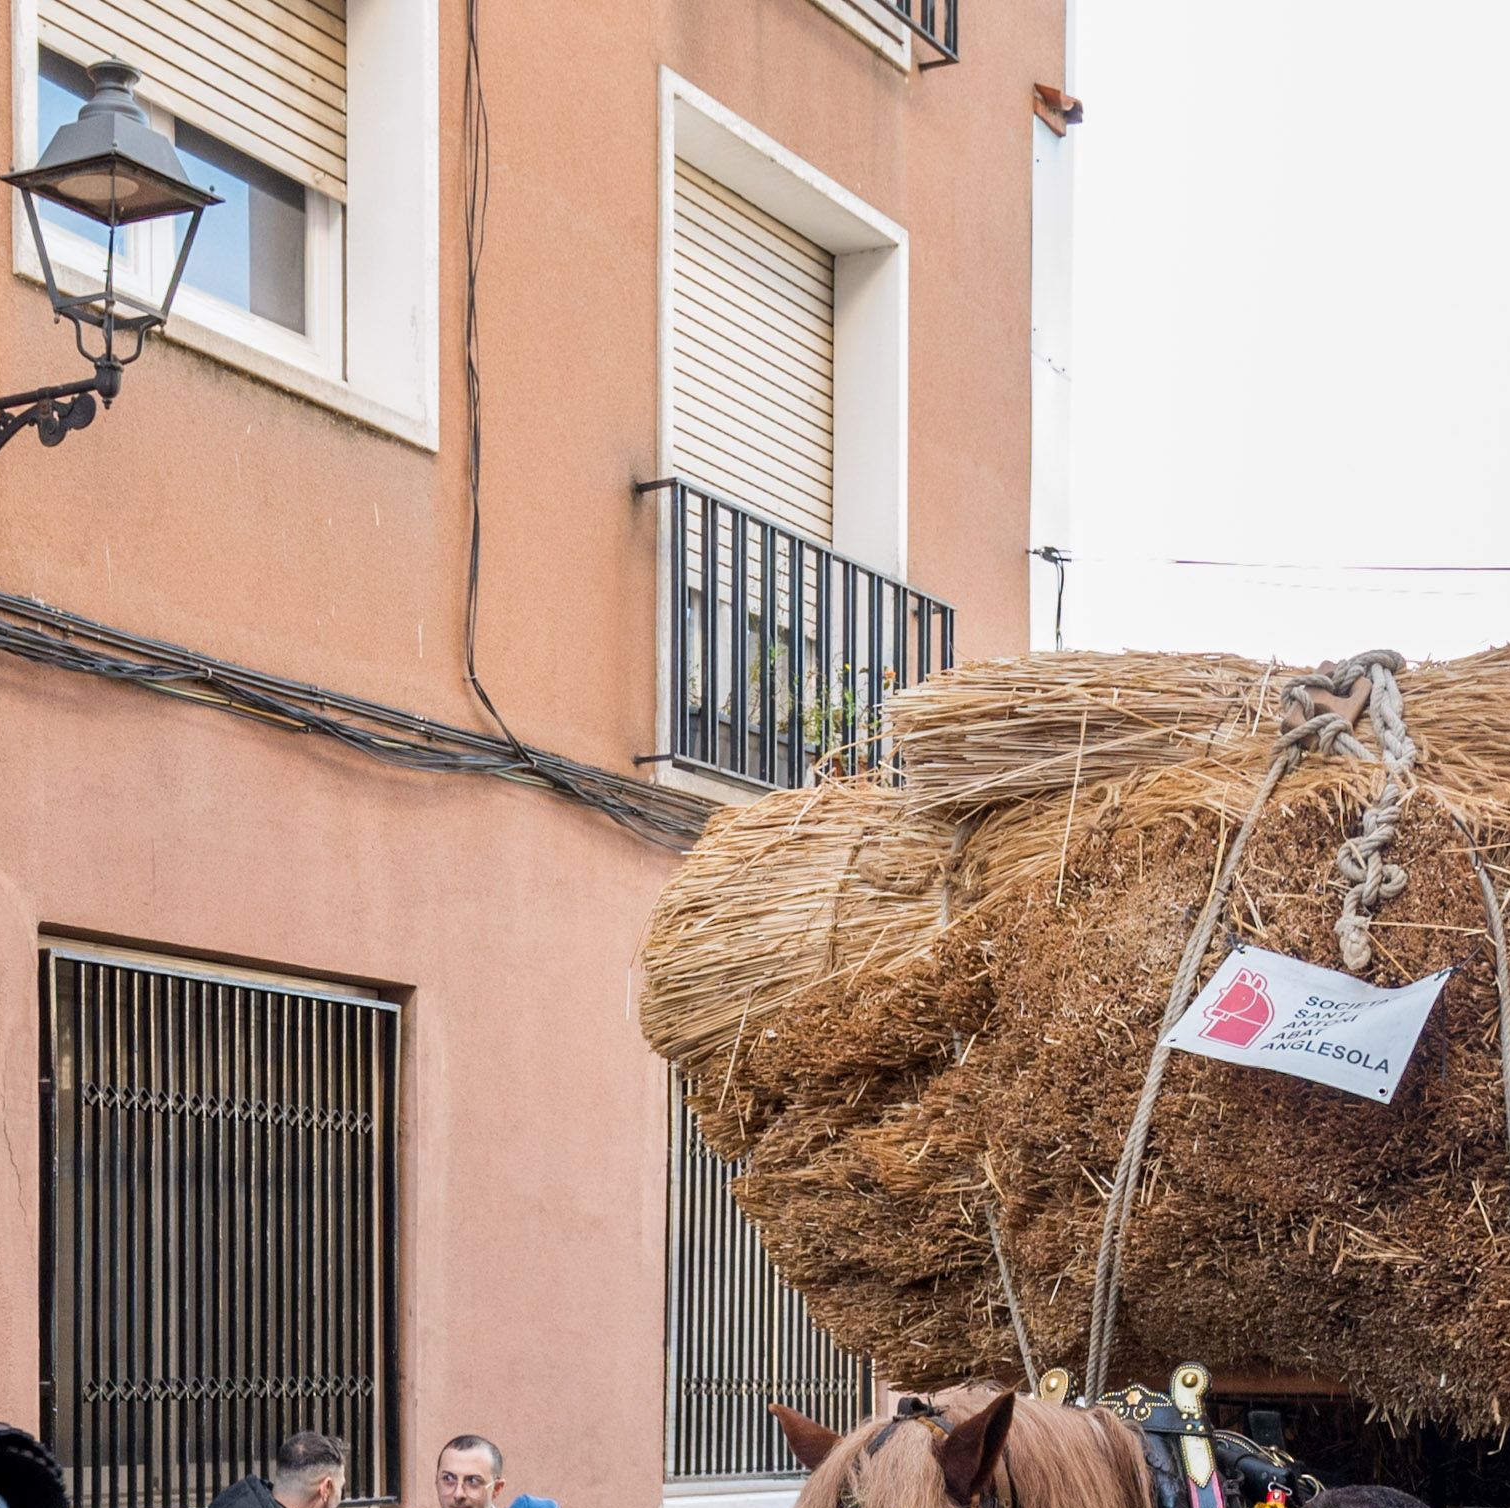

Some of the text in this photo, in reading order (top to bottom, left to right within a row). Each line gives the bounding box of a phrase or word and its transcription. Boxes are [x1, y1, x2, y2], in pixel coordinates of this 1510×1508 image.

[1305, 995, 1394, 1010] SOCIETA
[1283, 1014, 1359, 1029] ANTONI
[1295, 1009, 1348, 1019] SANT
[1271, 1028, 1323, 1040] ABAT
[1260, 1040, 1390, 1074] ANGLESOLA
